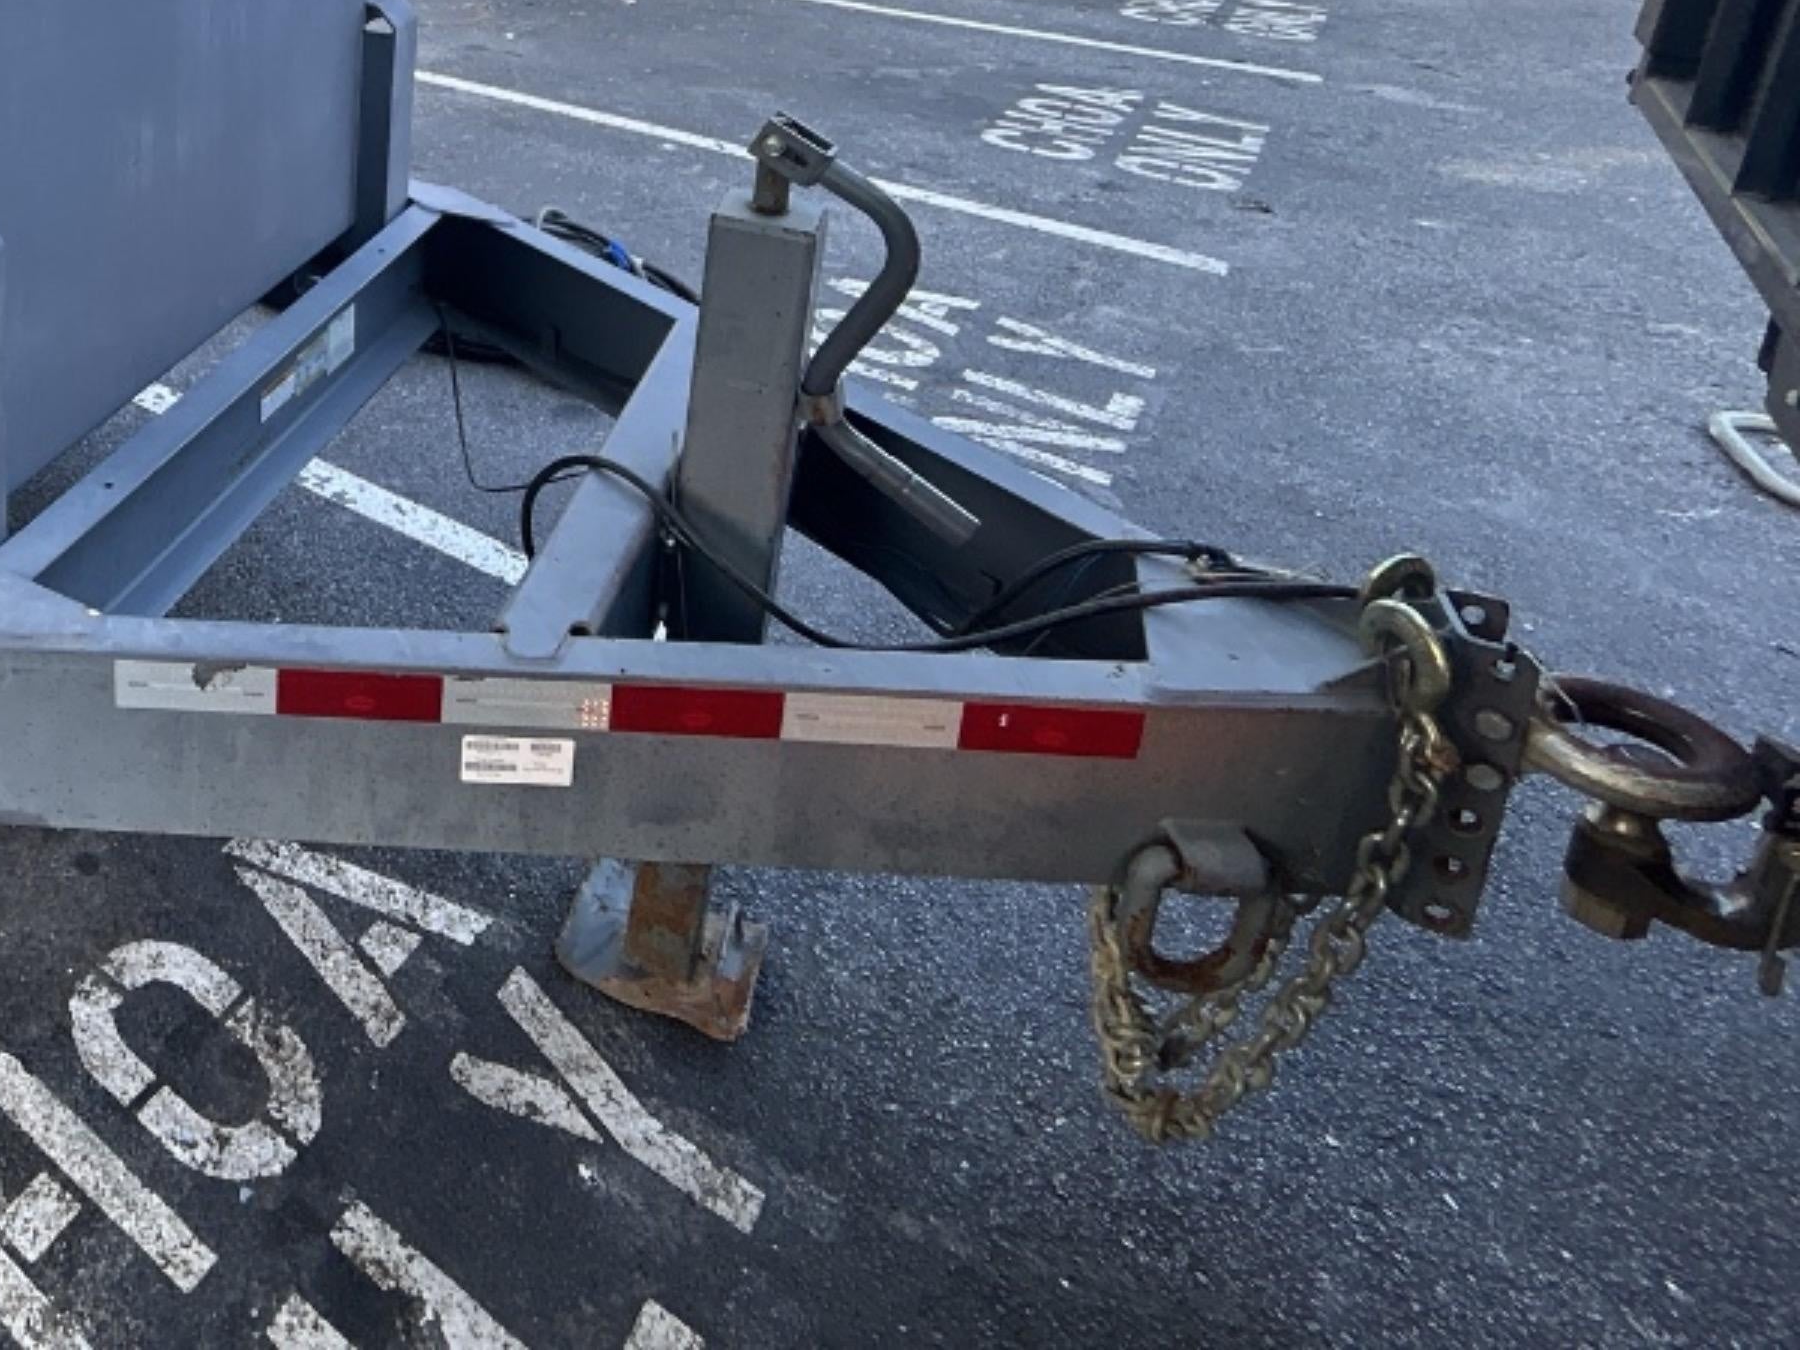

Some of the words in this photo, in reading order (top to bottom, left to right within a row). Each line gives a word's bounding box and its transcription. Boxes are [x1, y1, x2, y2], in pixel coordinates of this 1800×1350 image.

[981, 83, 1144, 161] CHOA
[1114, 101, 1271, 191] ONLY
[931, 315, 1158, 488] NLY
